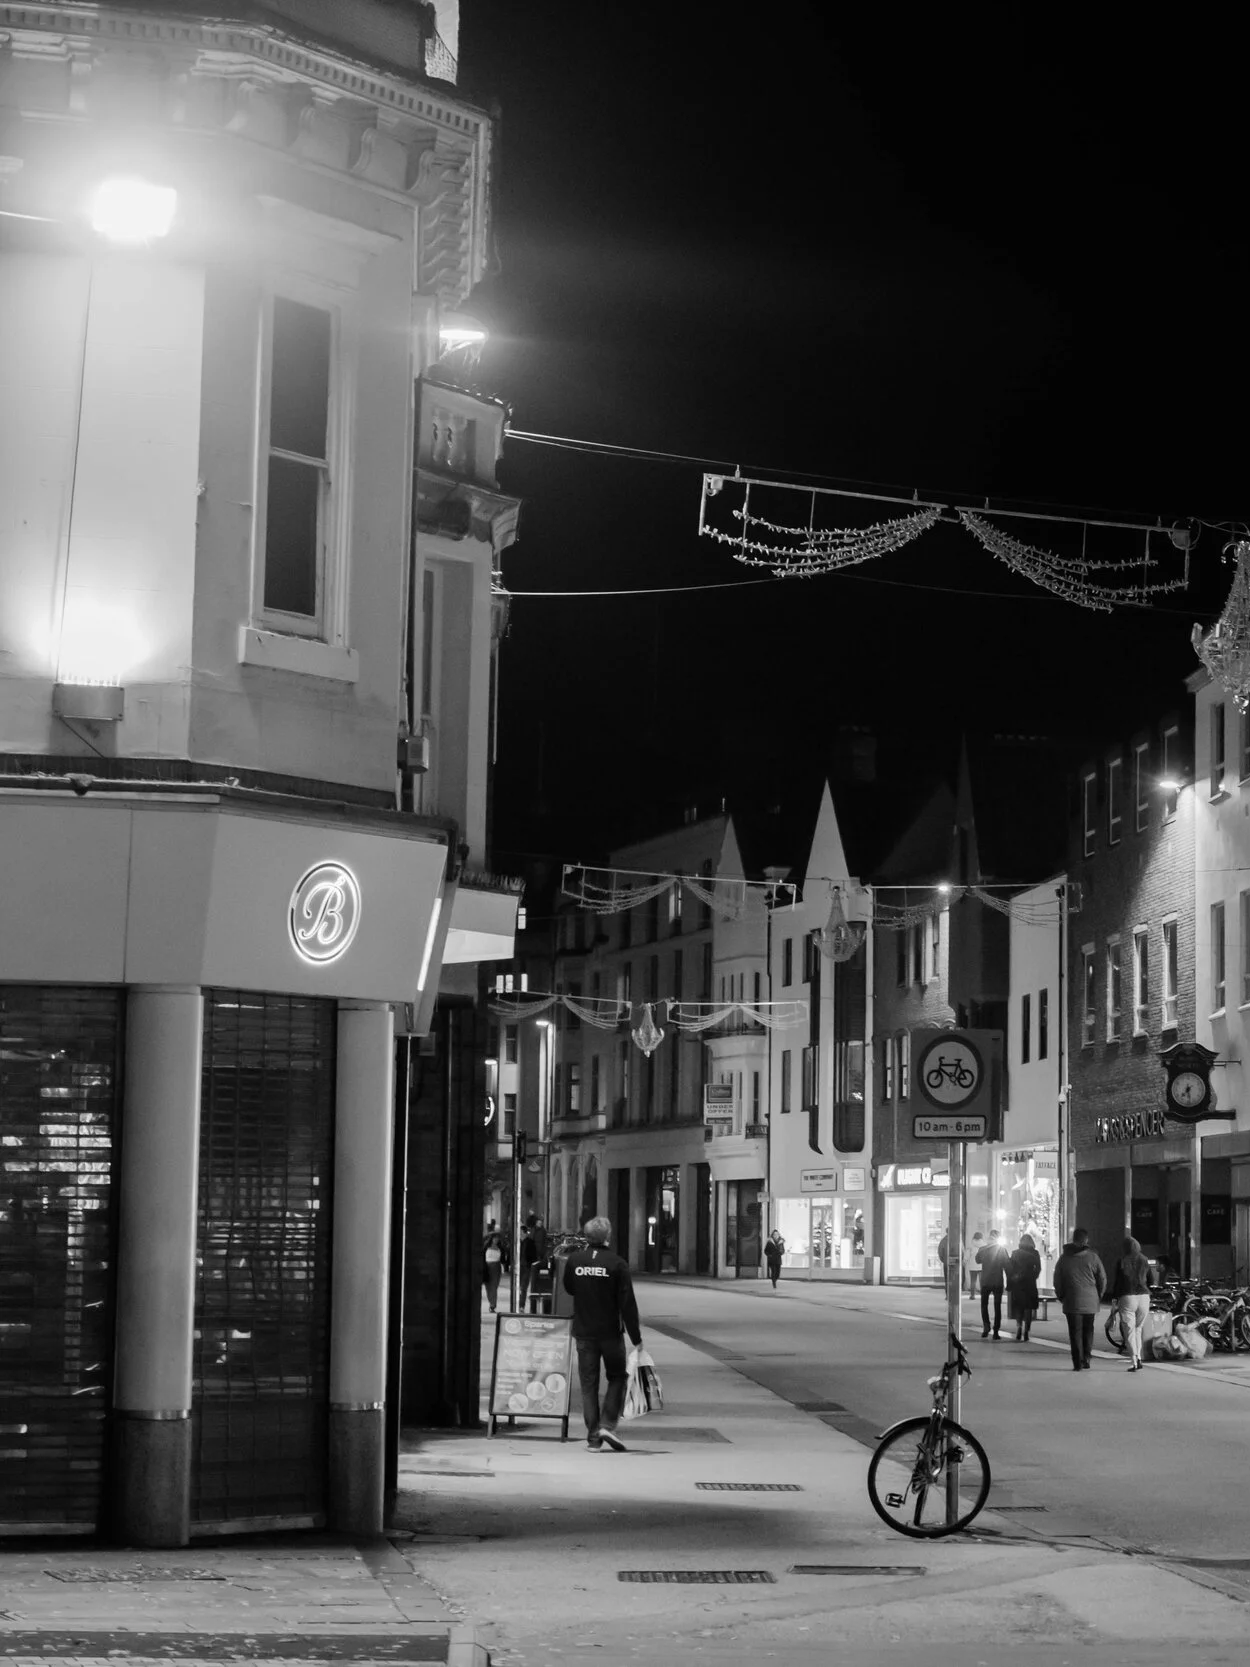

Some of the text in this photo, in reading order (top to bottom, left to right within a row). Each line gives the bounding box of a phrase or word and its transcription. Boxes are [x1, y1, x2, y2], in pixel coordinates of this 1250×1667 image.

[918, 1121, 931, 1132] 10
[933, 1124, 948, 1132] am
[955, 1121, 963, 1132] 6
[964, 1124, 981, 1134] pm
[574, 1266, 610, 1278] ORIEL
